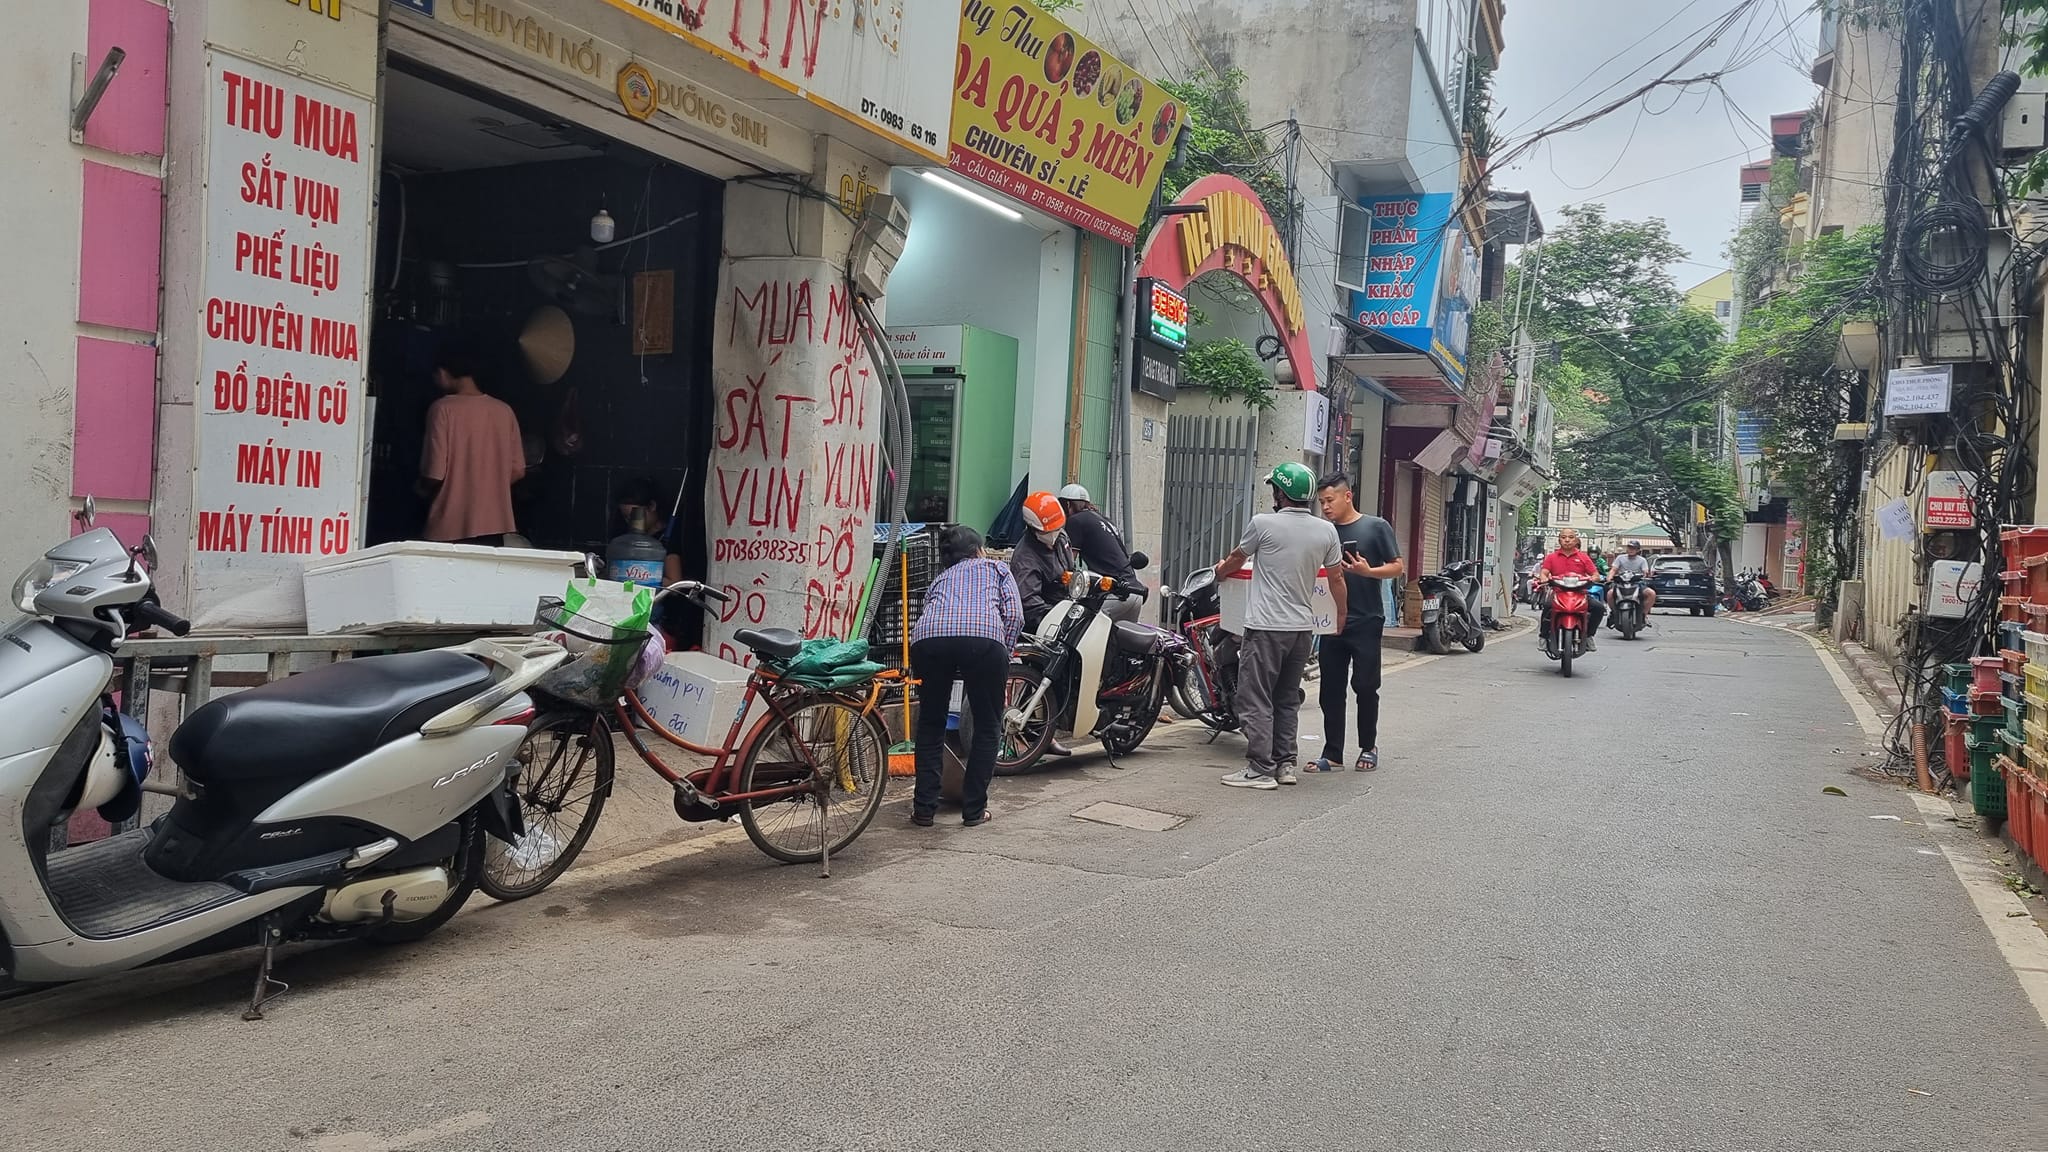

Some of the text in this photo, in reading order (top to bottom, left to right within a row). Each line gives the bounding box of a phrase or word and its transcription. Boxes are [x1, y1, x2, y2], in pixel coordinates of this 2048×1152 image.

[452, 0, 555, 59] CHUYÊN
[1000, 5, 1044, 60] Thu
[223, 71, 358, 163] THU MUA
[730, 112, 768, 148] SINH
[861, 97, 937, 146] ĐT: 0983 63 116
[993, 74, 1068, 145] QUẢ
[1060, 119, 1085, 159] 3
[1083, 121, 1154, 190] MIỀN
[241, 153, 340, 228] SẮT VỤN
[964, 125, 1038, 175] CHUYÊN
[1067, 174, 1090, 200] LẺ
[987, 169, 1010, 188] GIẤY
[1014, 181, 1029, 196] HN
[1031, 188, 1047, 205] ĐT:
[1045, 195, 1064, 214] 0588
[1063, 205, 1074, 216] 41
[1073, 208, 1092, 225] 7777
[1092, 217, 1109, 233] 0337
[1109, 225, 1122, 239] 666
[1177, 191, 1226, 276] NEW
[1223, 189, 1264, 260] LAND
[1370, 221, 1417, 245] PHẨM
[1374, 199, 1419, 221] THỰC
[236, 229, 340, 297] PHẾ LIỆU
[1366, 276, 1416, 299] KHẨU
[1369, 253, 1417, 276] NHẬP
[206, 297, 359, 361] CHUYÊN MUA
[729, 278, 814, 349] MUA
[1359, 304, 1421, 327] CAO CẤP
[214, 360, 348, 427] ĐỒ ĐIỆN CŨ
[718, 351, 817, 460] SẮT
[236, 438, 322, 488] MÁY IN
[197, 504, 350, 555] MÁY TÍNH CŨ
[716, 466, 804, 537] VỤN
